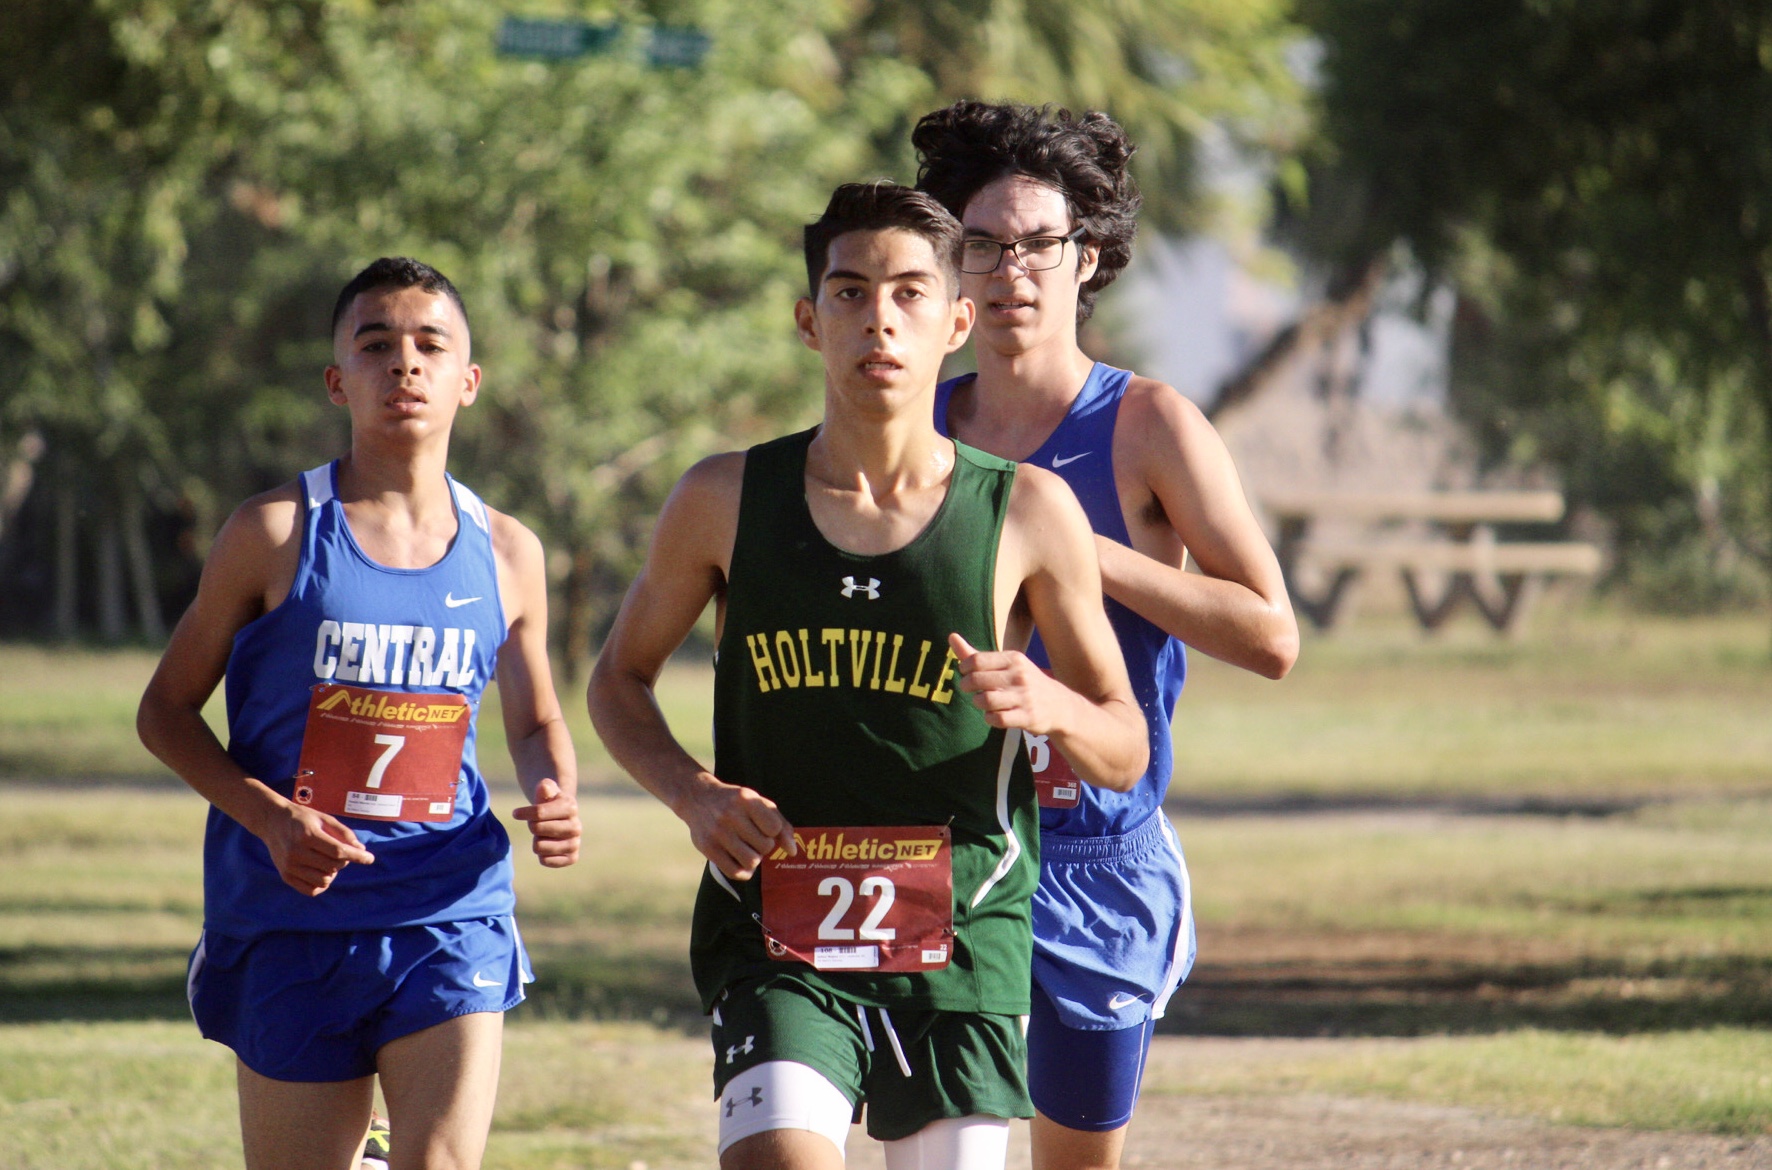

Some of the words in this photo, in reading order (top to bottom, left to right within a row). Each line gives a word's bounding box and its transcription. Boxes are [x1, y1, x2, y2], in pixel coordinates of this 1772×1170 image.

[313, 619, 476, 687] CENTRAL
[746, 628, 961, 704] HOLTVILLE
[365, 733, 406, 789] 7
[817, 876, 896, 940] 22
